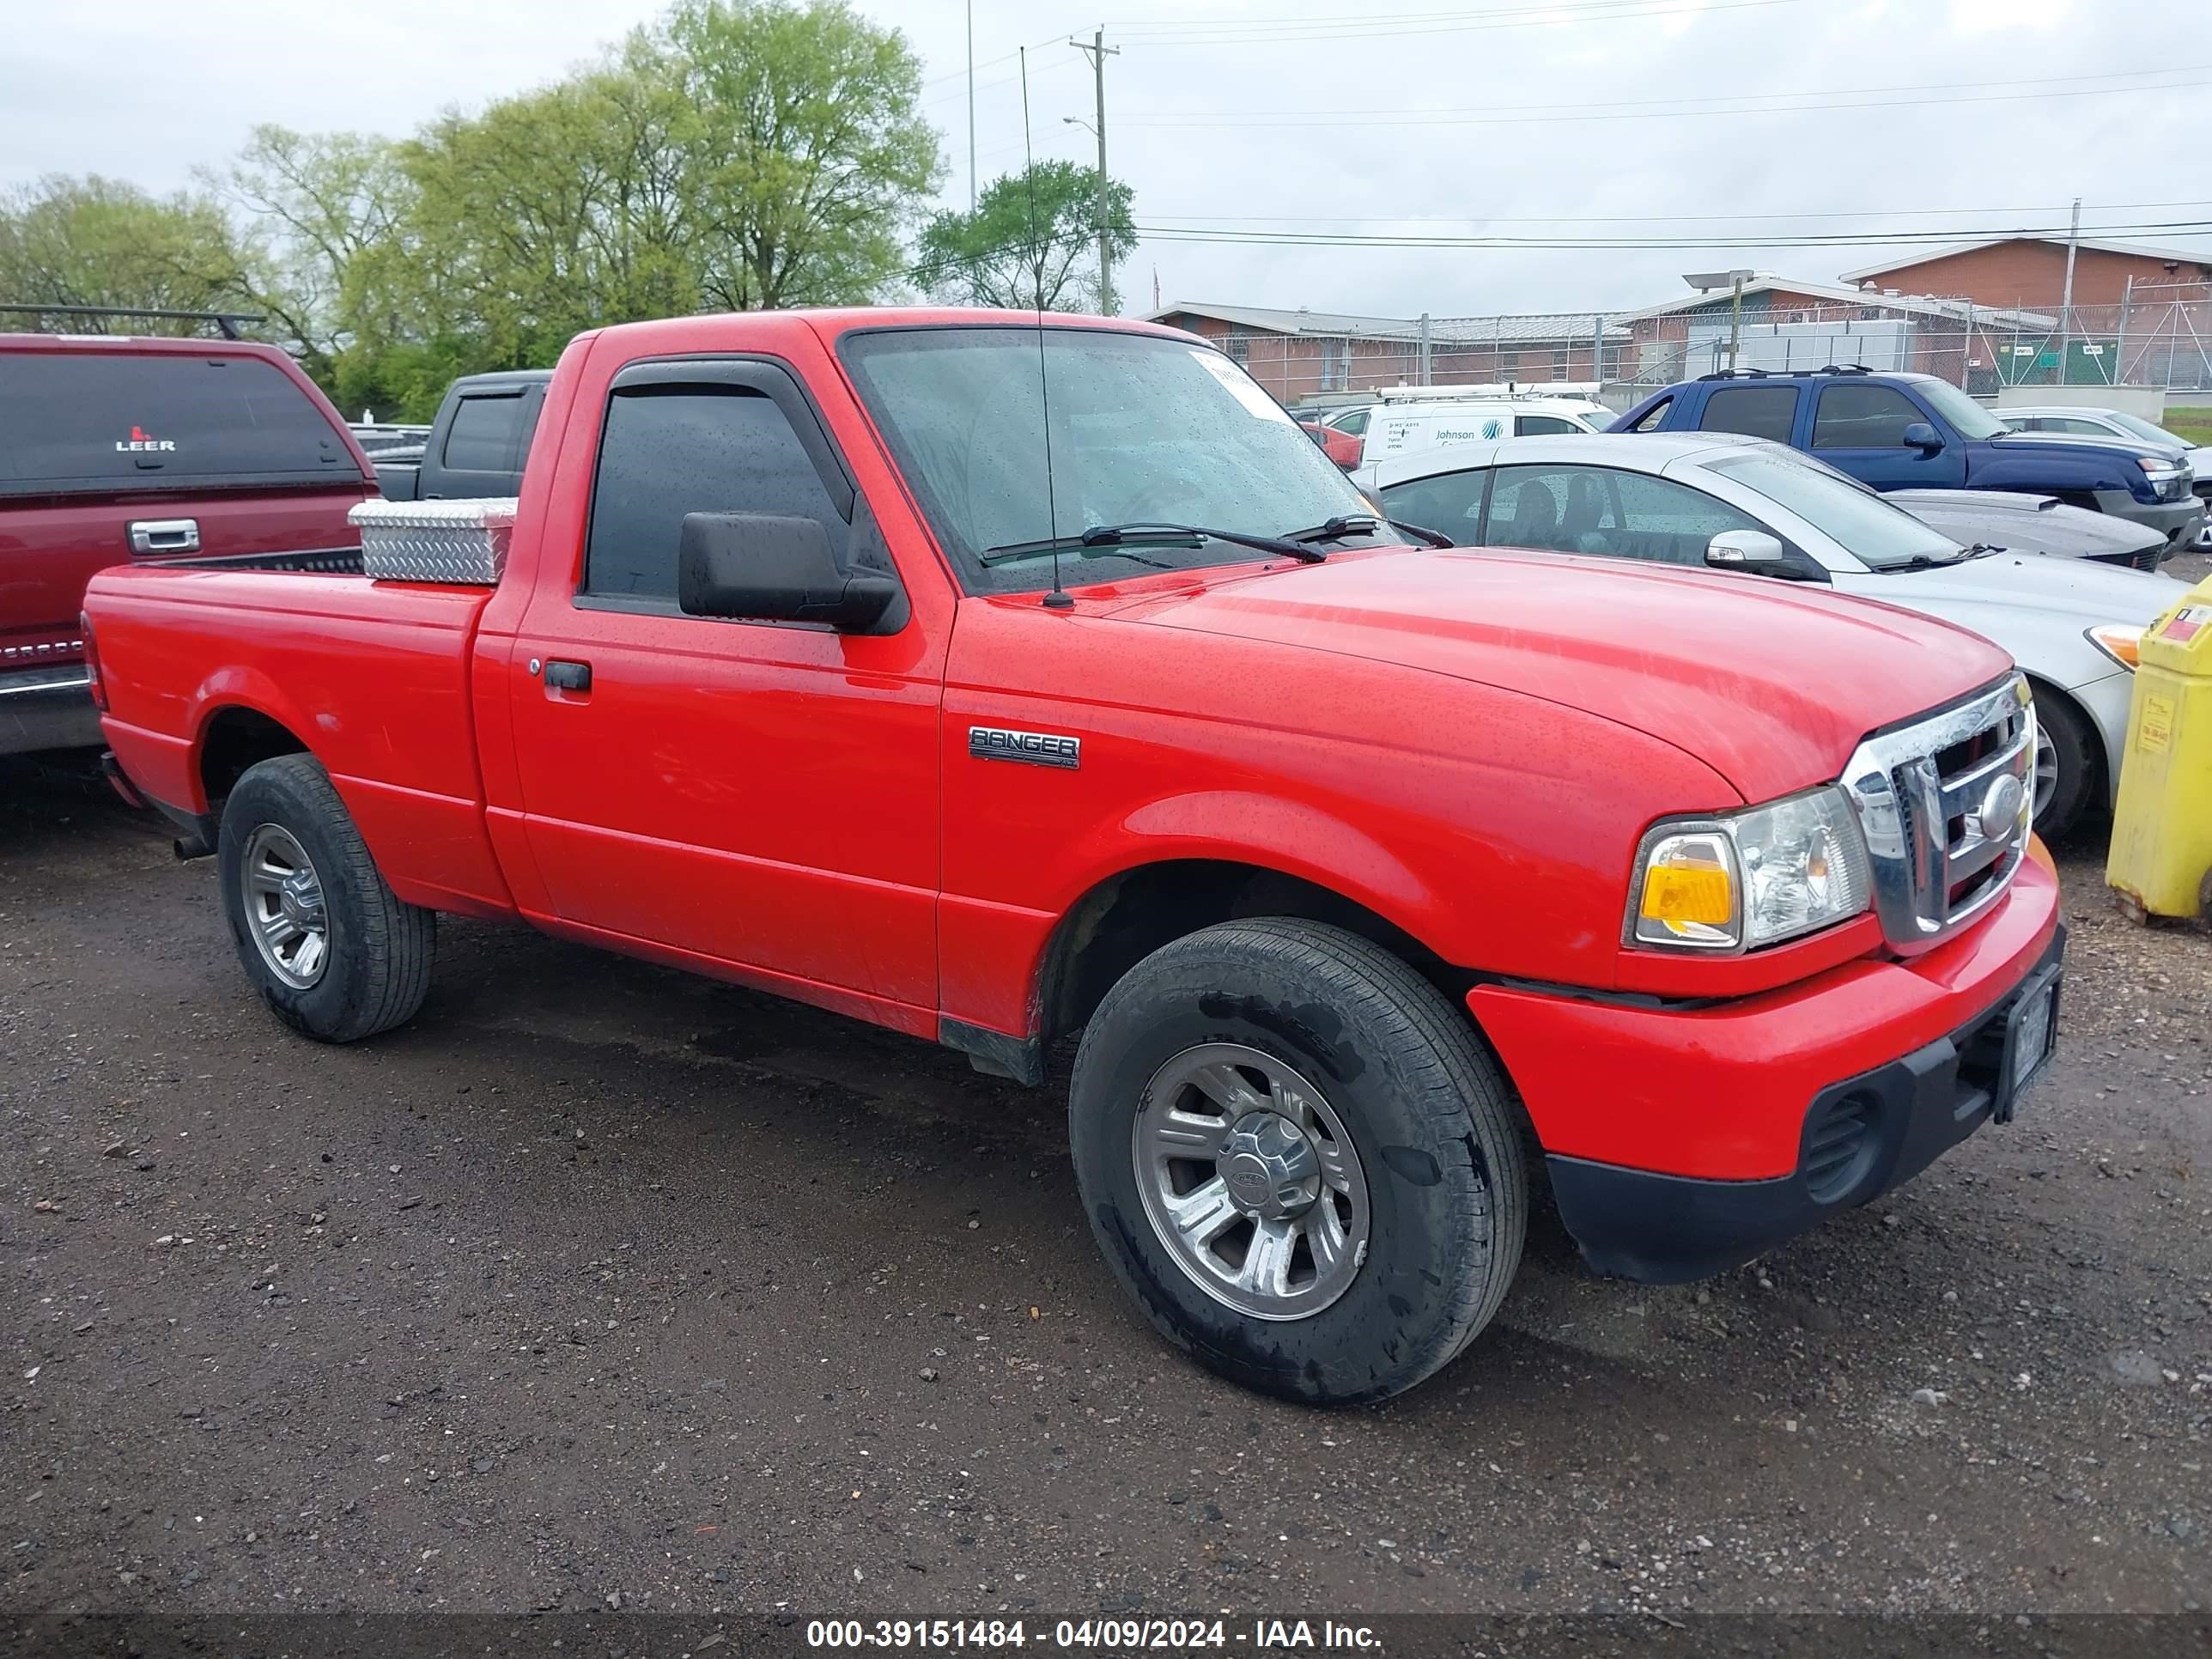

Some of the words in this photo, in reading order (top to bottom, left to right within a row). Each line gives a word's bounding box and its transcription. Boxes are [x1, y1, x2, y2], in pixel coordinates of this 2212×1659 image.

[1436, 429, 1474, 440] Johnson
[116, 440, 176, 452] LEER
[970, 728, 1078, 757] RANGER
